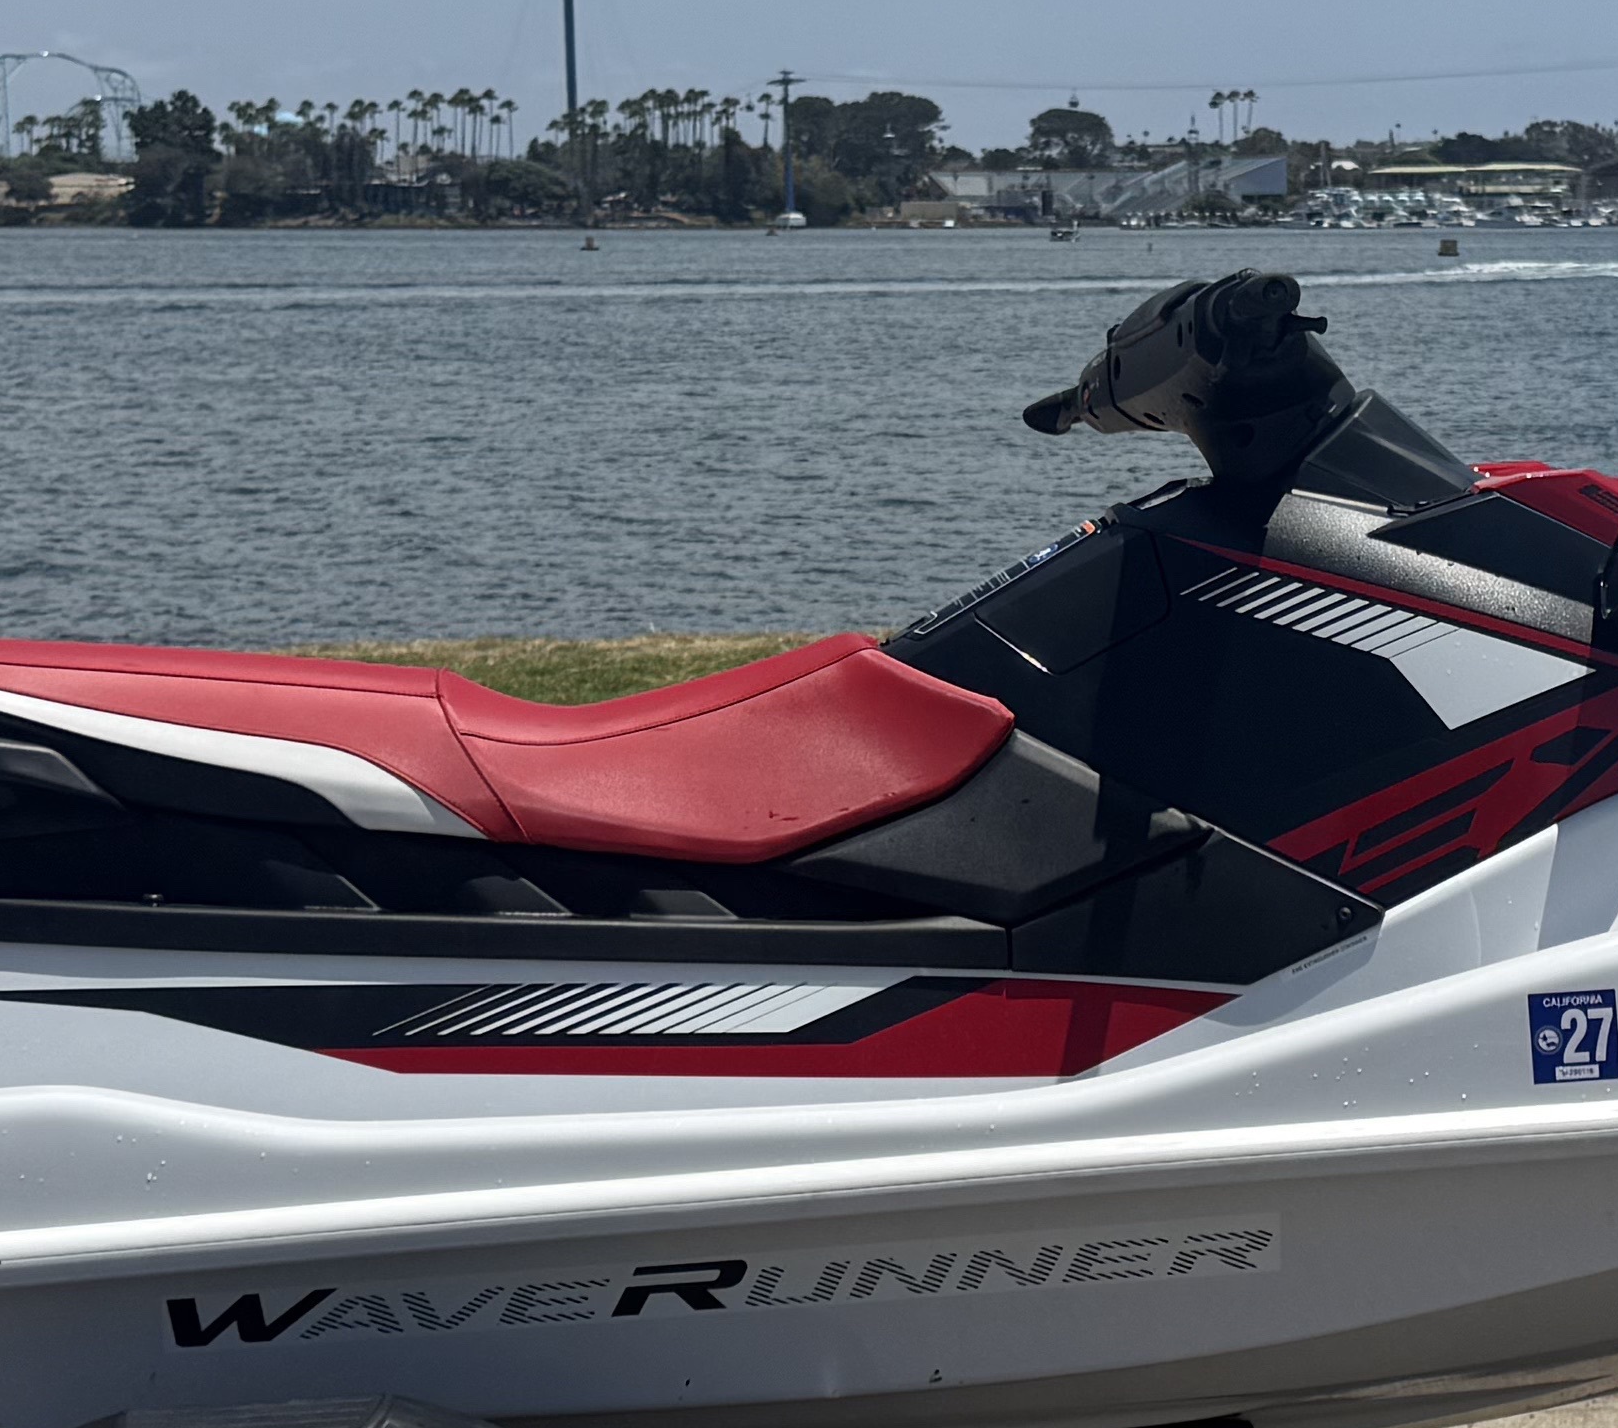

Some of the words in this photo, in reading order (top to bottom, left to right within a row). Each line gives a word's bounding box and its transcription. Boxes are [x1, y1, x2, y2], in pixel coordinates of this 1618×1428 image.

[1543, 994, 1603, 1008] CALIFORNIA
[1560, 1007, 1613, 1064] 27
[166, 1229, 1274, 1348] WAVERUNNER
